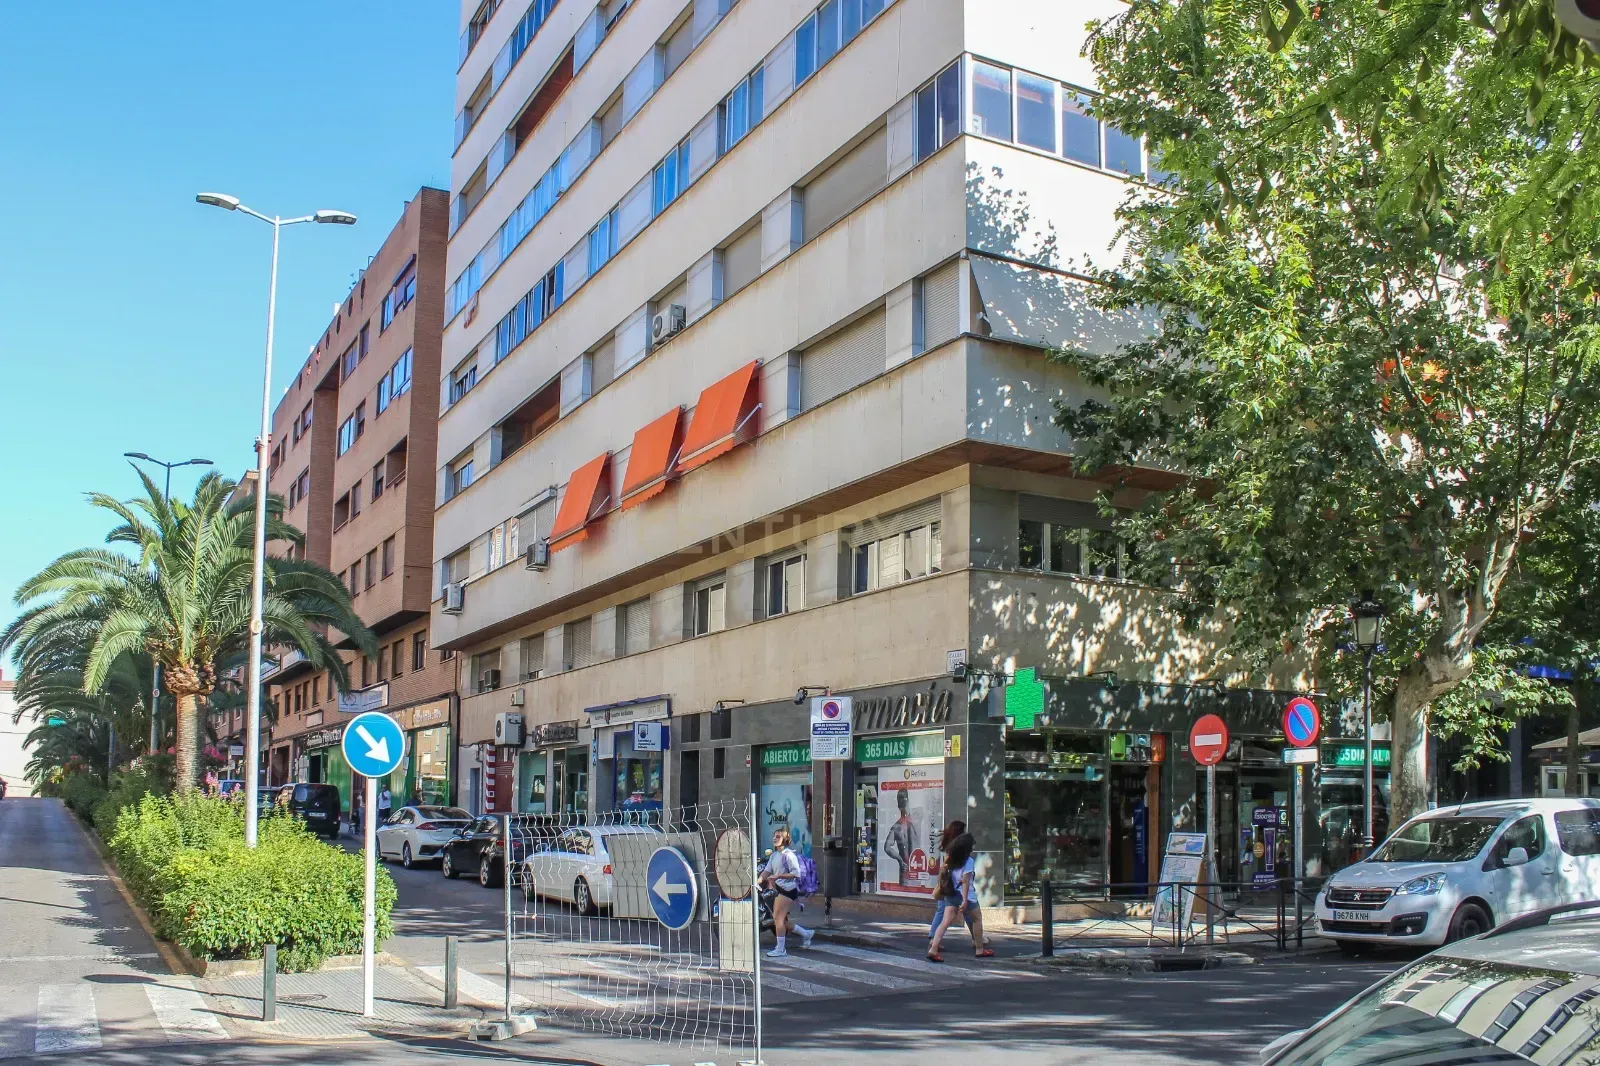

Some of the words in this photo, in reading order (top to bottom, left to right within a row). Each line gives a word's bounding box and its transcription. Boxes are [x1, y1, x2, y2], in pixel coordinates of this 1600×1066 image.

[865, 743, 881, 758] 365
[883, 741, 905, 757] DIAS
[908, 740, 920, 755] AL
[1372, 749, 1384, 762] AL
[763, 749, 799, 764] ABIERTO
[1336, 911, 1354, 920] 9678
[1355, 912, 1369, 921] KNH
